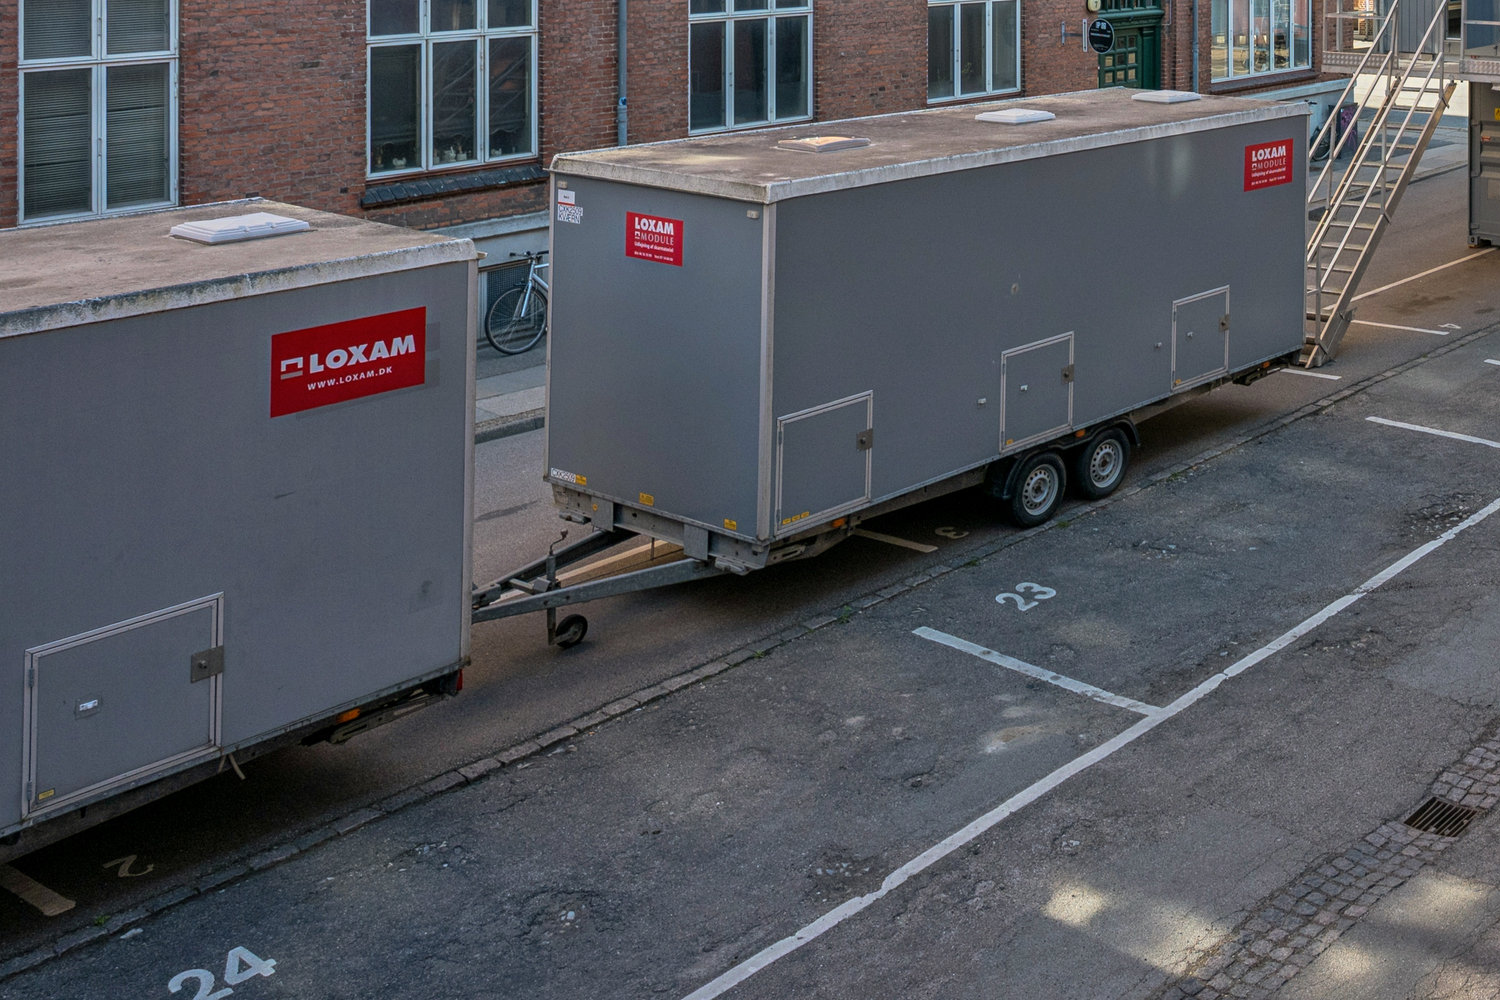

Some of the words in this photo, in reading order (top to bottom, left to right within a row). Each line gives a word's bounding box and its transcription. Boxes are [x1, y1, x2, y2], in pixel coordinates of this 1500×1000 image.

[1252, 145, 1286, 161] LOXAM
[1258, 158, 1286, 169] MODULE
[635, 217, 674, 235] LOXAM
[641, 232, 674, 245] MODULE
[310, 334, 416, 374] LOXAM
[307, 366, 393, 391] WWW.LOXAM.DK
[935, 526, 969, 539] 3
[995, 582, 1057, 612] 23
[103, 854, 154, 878] 2
[168, 945, 277, 1000] 24
